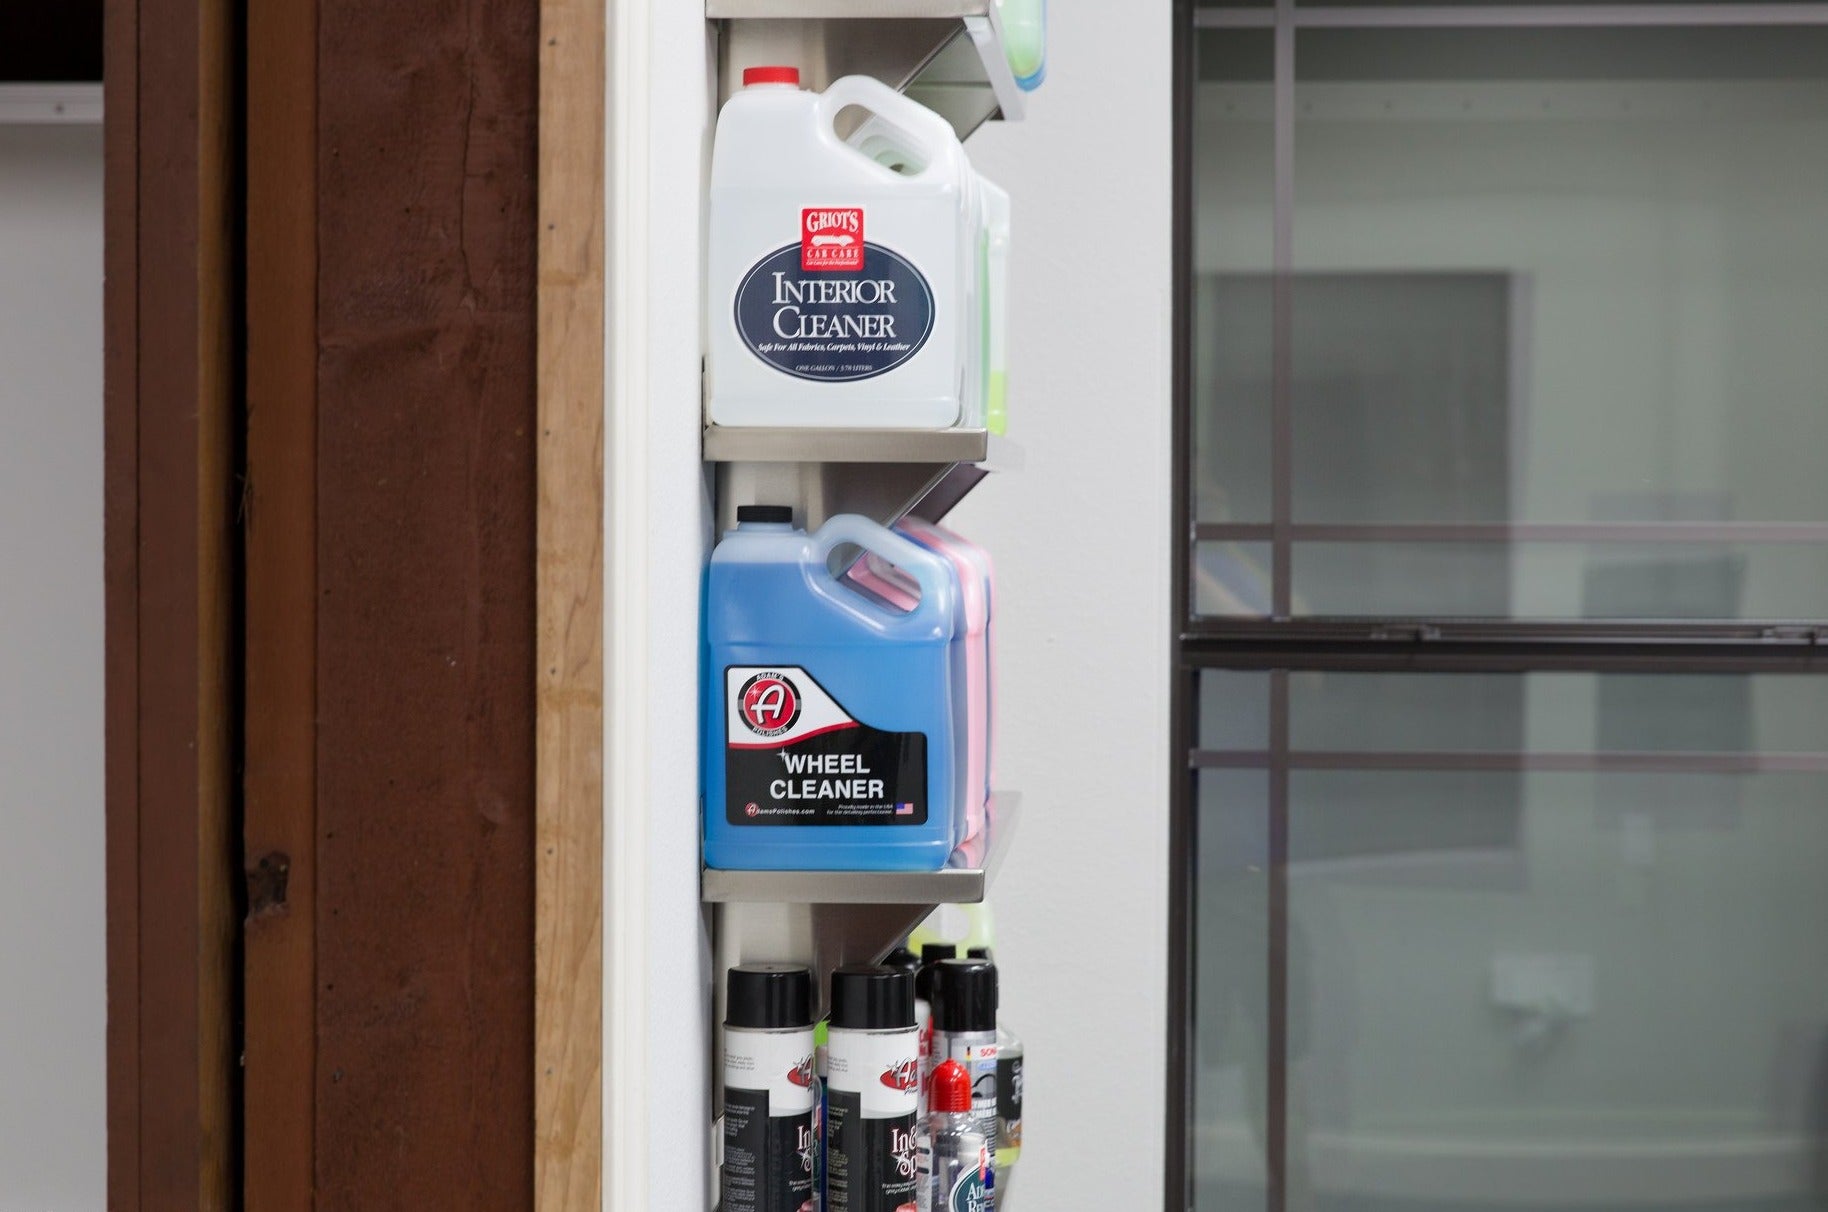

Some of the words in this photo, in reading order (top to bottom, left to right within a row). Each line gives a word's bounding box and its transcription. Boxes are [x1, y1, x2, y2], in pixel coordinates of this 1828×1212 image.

[806, 210, 859, 233] GRIOT'S
[806, 248, 828, 258] CAR
[831, 248, 858, 258] CARE
[772, 271, 897, 304] INTERIOR
[772, 305, 897, 339] CLEANER
[758, 342, 773, 353] Safe
[774, 342, 787, 351] For
[787, 342, 798, 351] All
[798, 342, 826, 352] Fabrics,
[827, 342, 856, 353] Carpets,
[857, 342, 876, 352] Vinyl
[876, 342, 883, 351] &
[883, 342, 911, 351] Leather
[785, 754, 870, 774] WHEEL
[769, 779, 884, 799] CLEANER
[979, 1047, 997, 1057] SON
[797, 1125, 812, 1151] In
[890, 1125, 917, 1153] In&
[899, 1150, 917, 1178] Sp
